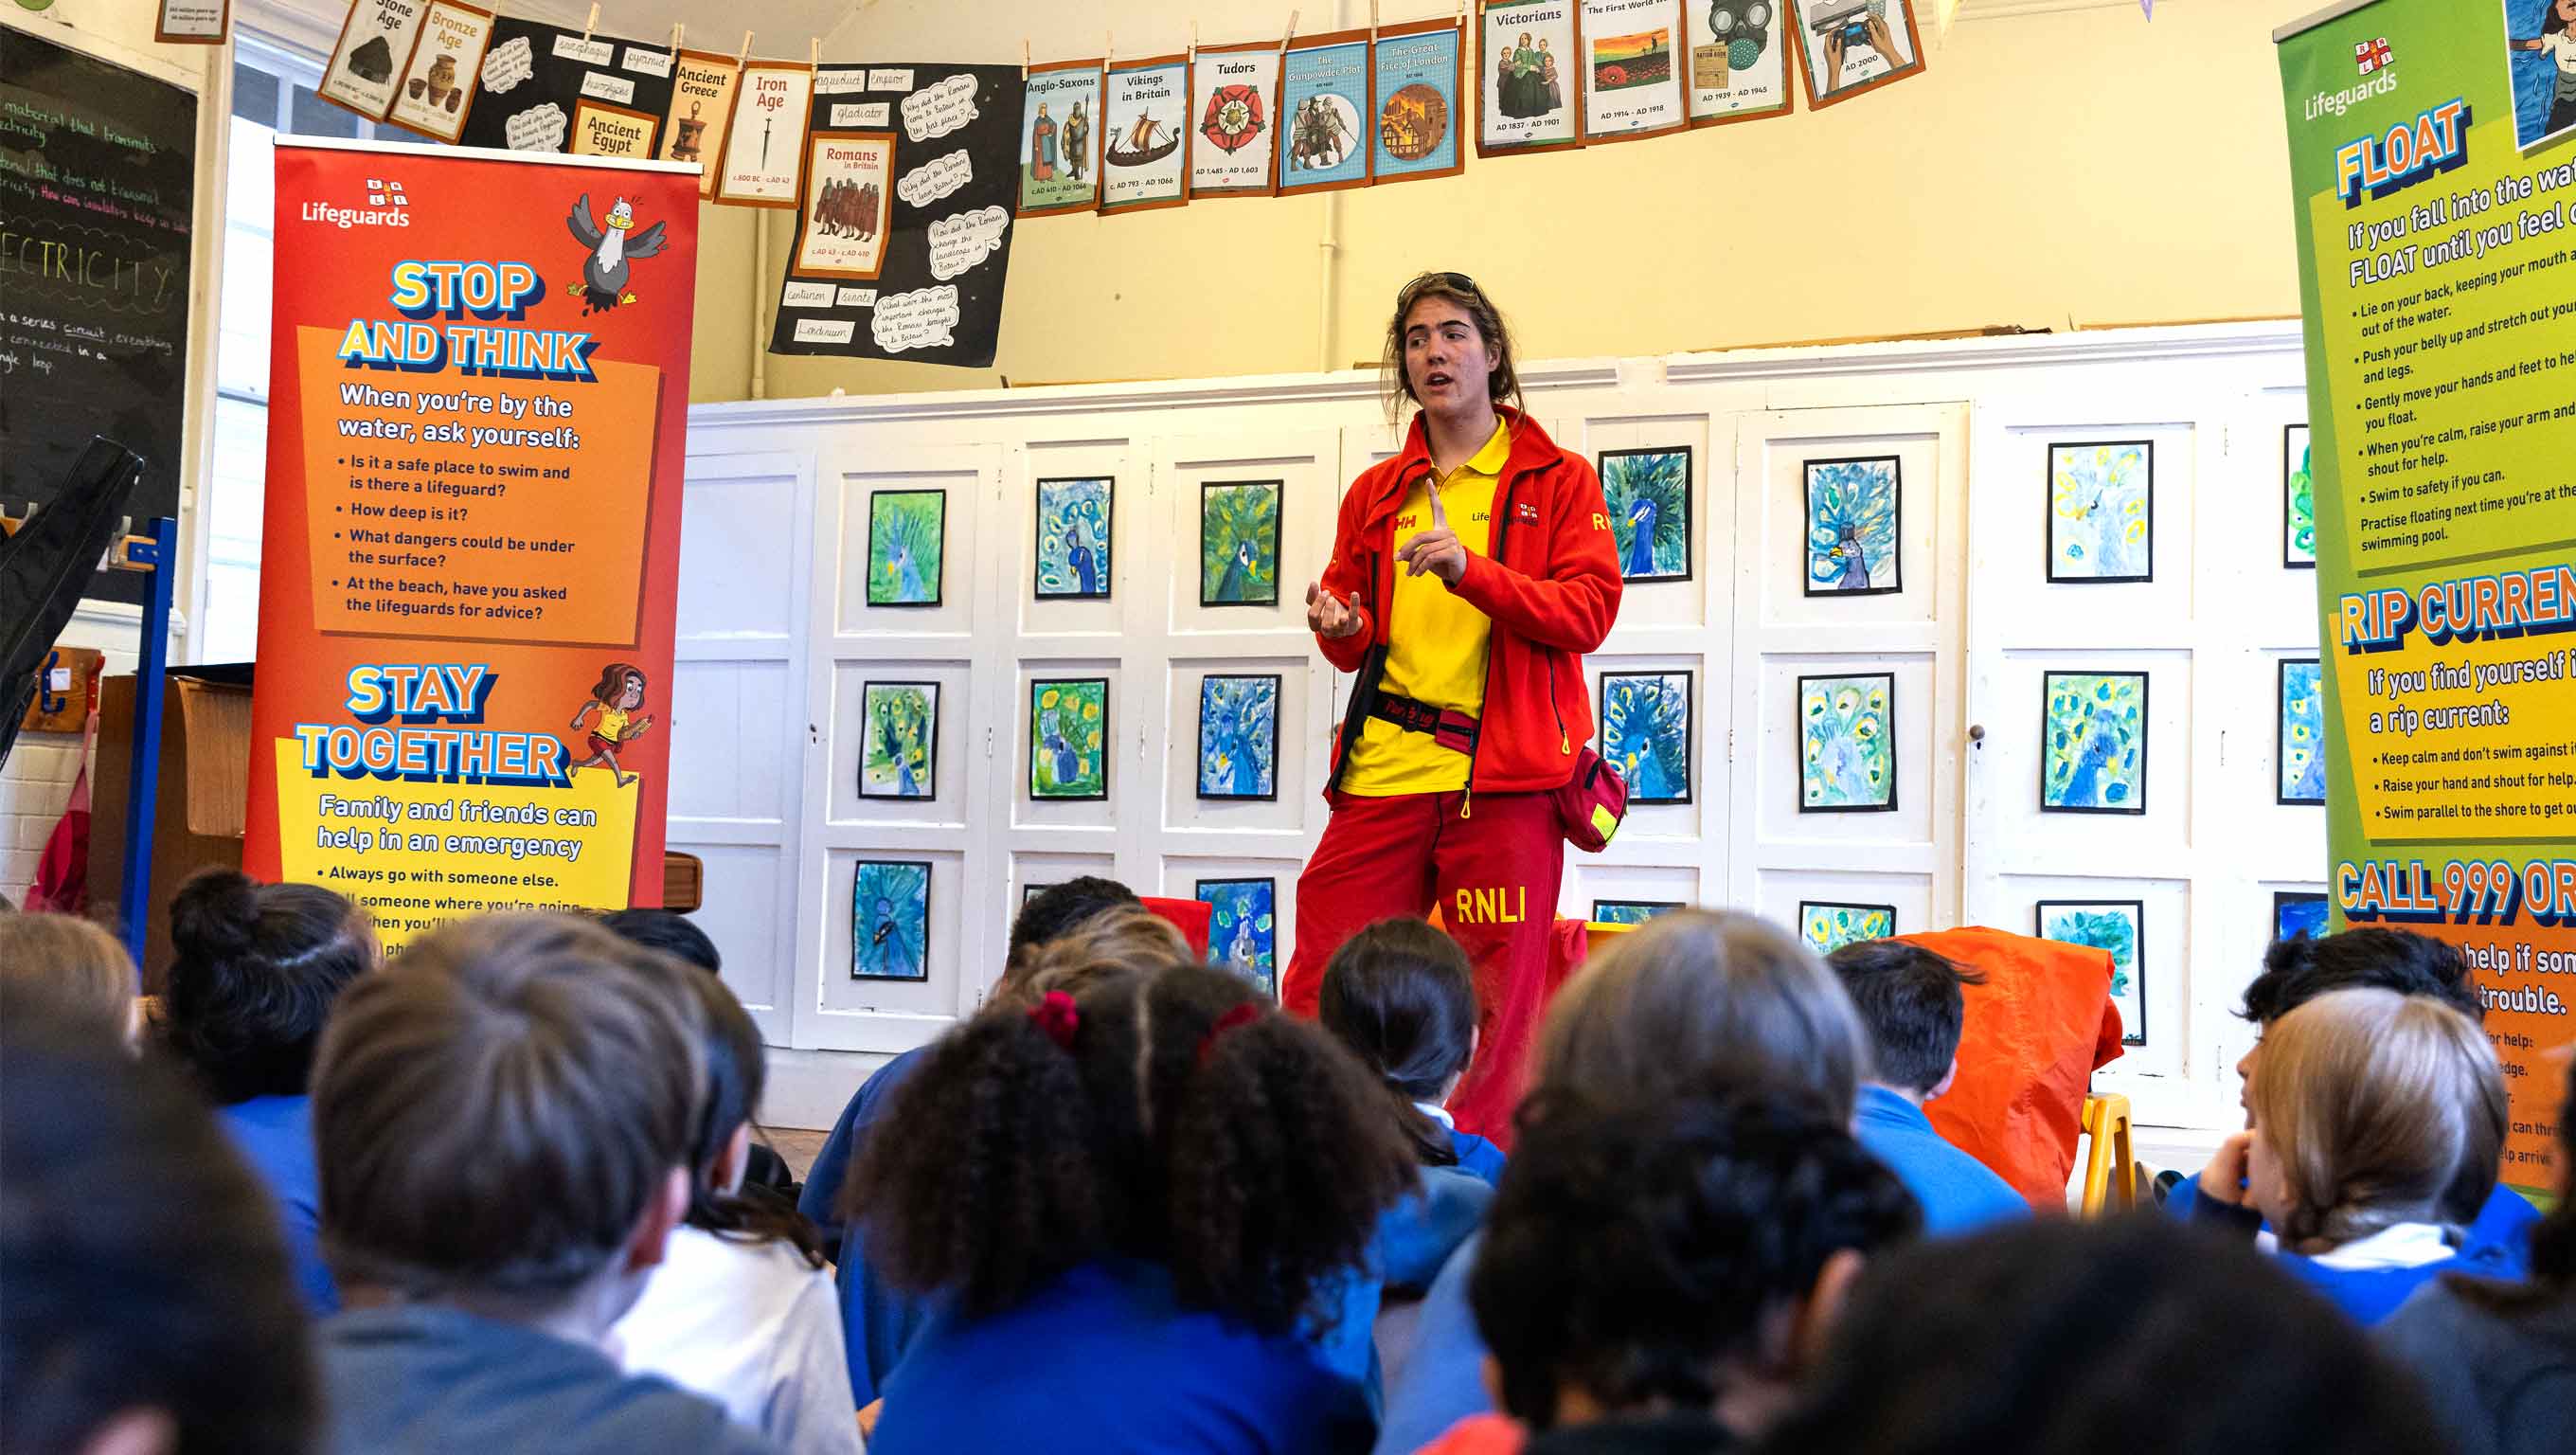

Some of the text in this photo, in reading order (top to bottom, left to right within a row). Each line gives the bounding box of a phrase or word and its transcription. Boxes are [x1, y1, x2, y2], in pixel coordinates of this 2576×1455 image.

[1588, 0, 1654, 15] The First World
[377, 10, 402, 29] Age
[431, 10, 477, 37] Bronze
[1496, 9, 1562, 27] Victorians
[437, 29, 462, 50] Age
[1317, 56, 1333, 65] The
[1391, 44, 1440, 58] The Great
[1217, 63, 1256, 75] Tudors
[1289, 63, 1362, 82] Gunpowder Plot
[1381, 53, 1448, 72] Fire of London
[1845, 54, 1878, 72] AD 2000
[677, 66, 727, 86] Ancient
[756, 76, 788, 92] Iron
[1126, 75, 1164, 88] Vikings
[681, 81, 718, 99] Greece
[1028, 78, 1095, 95] Anglo-Saxons
[1121, 88, 1171, 102] in Britain
[1715, 91, 1731, 100] 1939
[1750, 86, 1767, 96] 1945
[2304, 69, 2397, 121] Lifeguards
[756, 93, 784, 113] Age
[1601, 104, 1664, 120] AD 1914 AD 1918
[837, 105, 883, 124] gladiator
[1531, 119, 1542, 128] AD
[1544, 118, 1560, 127] 1901
[70, 116, 94, 135] that
[587, 117, 642, 141] Ancient
[592, 132, 633, 154] Egypt
[2334, 97, 2468, 203] FLOAT
[827, 148, 878, 162] Romans
[853, 162, 879, 171] Britain
[1242, 167, 1258, 175] 1,603
[1145, 179, 1155, 188] AD
[1157, 177, 1173, 186] 1066
[302, 203, 410, 229] Lifeguards
[2348, 222, 2365, 251] If
[2369, 216, 2406, 251] you
[2410, 197, 2447, 234] fall
[2450, 189, 2491, 220] into
[2495, 175, 2532, 208] the
[2349, 202, 2564, 289] FLOAT until you feel
[390, 260, 538, 314] STOP
[2360, 249, 2567, 318] Lie on your back, keeping your mouth
[9, 313, 17, 323] a
[22, 315, 56, 331] series
[79, 345, 106, 360] in a
[337, 319, 595, 377] AND THINK
[340, 384, 572, 419] When you're by the
[338, 419, 580, 450] water, ask yourself:
[2369, 469, 2505, 503] Swim to safety if you can.
[351, 503, 468, 521] How deep is it?
[2340, 587, 2411, 650] RIP
[2368, 650, 2565, 700] If you find yourself
[346, 663, 492, 718] STAY
[2370, 699, 2509, 737] a rip current:
[295, 723, 570, 781] TOGETHER
[319, 794, 597, 828] Family and friends can
[317, 826, 582, 862] help in an emergency
[329, 867, 560, 889] Always go with someone else.
[2335, 858, 2576, 920] CALL 999 OR
[1456, 886, 1526, 925] RNLI
